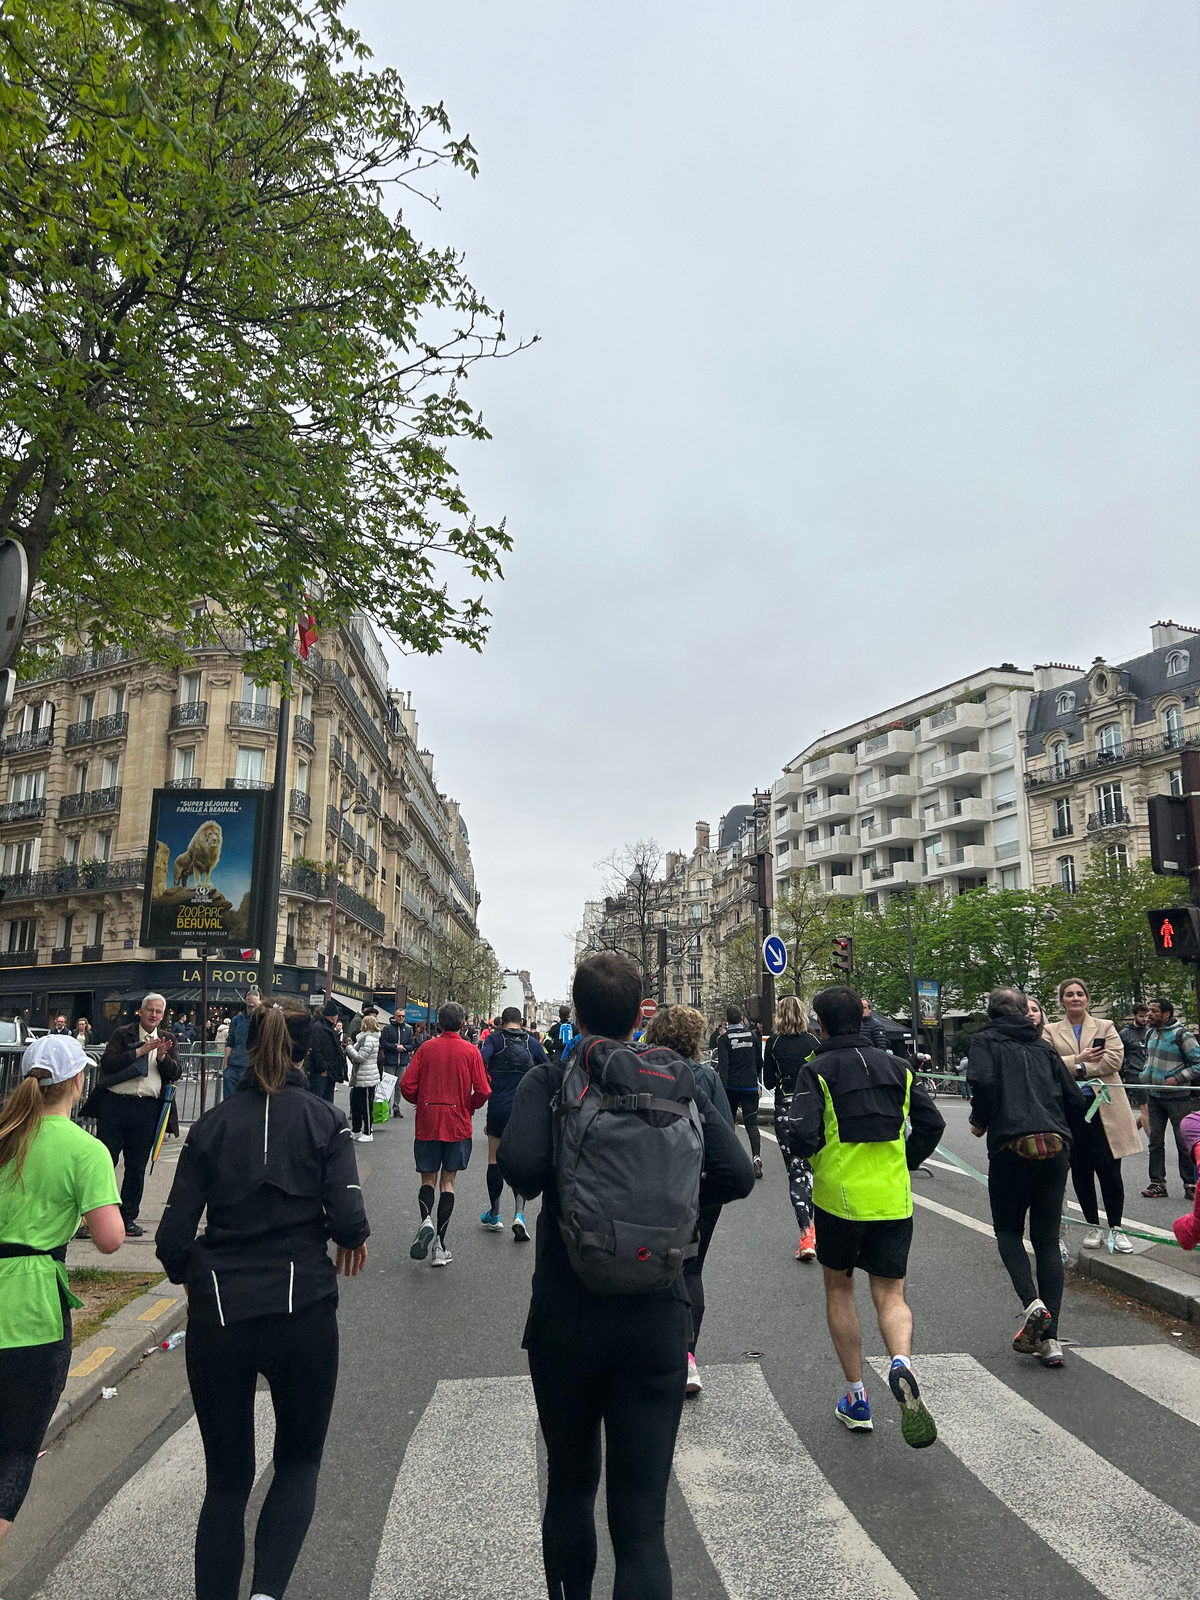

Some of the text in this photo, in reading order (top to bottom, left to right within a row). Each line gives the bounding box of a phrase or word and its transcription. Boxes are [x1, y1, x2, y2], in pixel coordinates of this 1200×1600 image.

[176, 918, 223, 929] BEAUVAL
[182, 969, 283, 985] LA ROTOE
